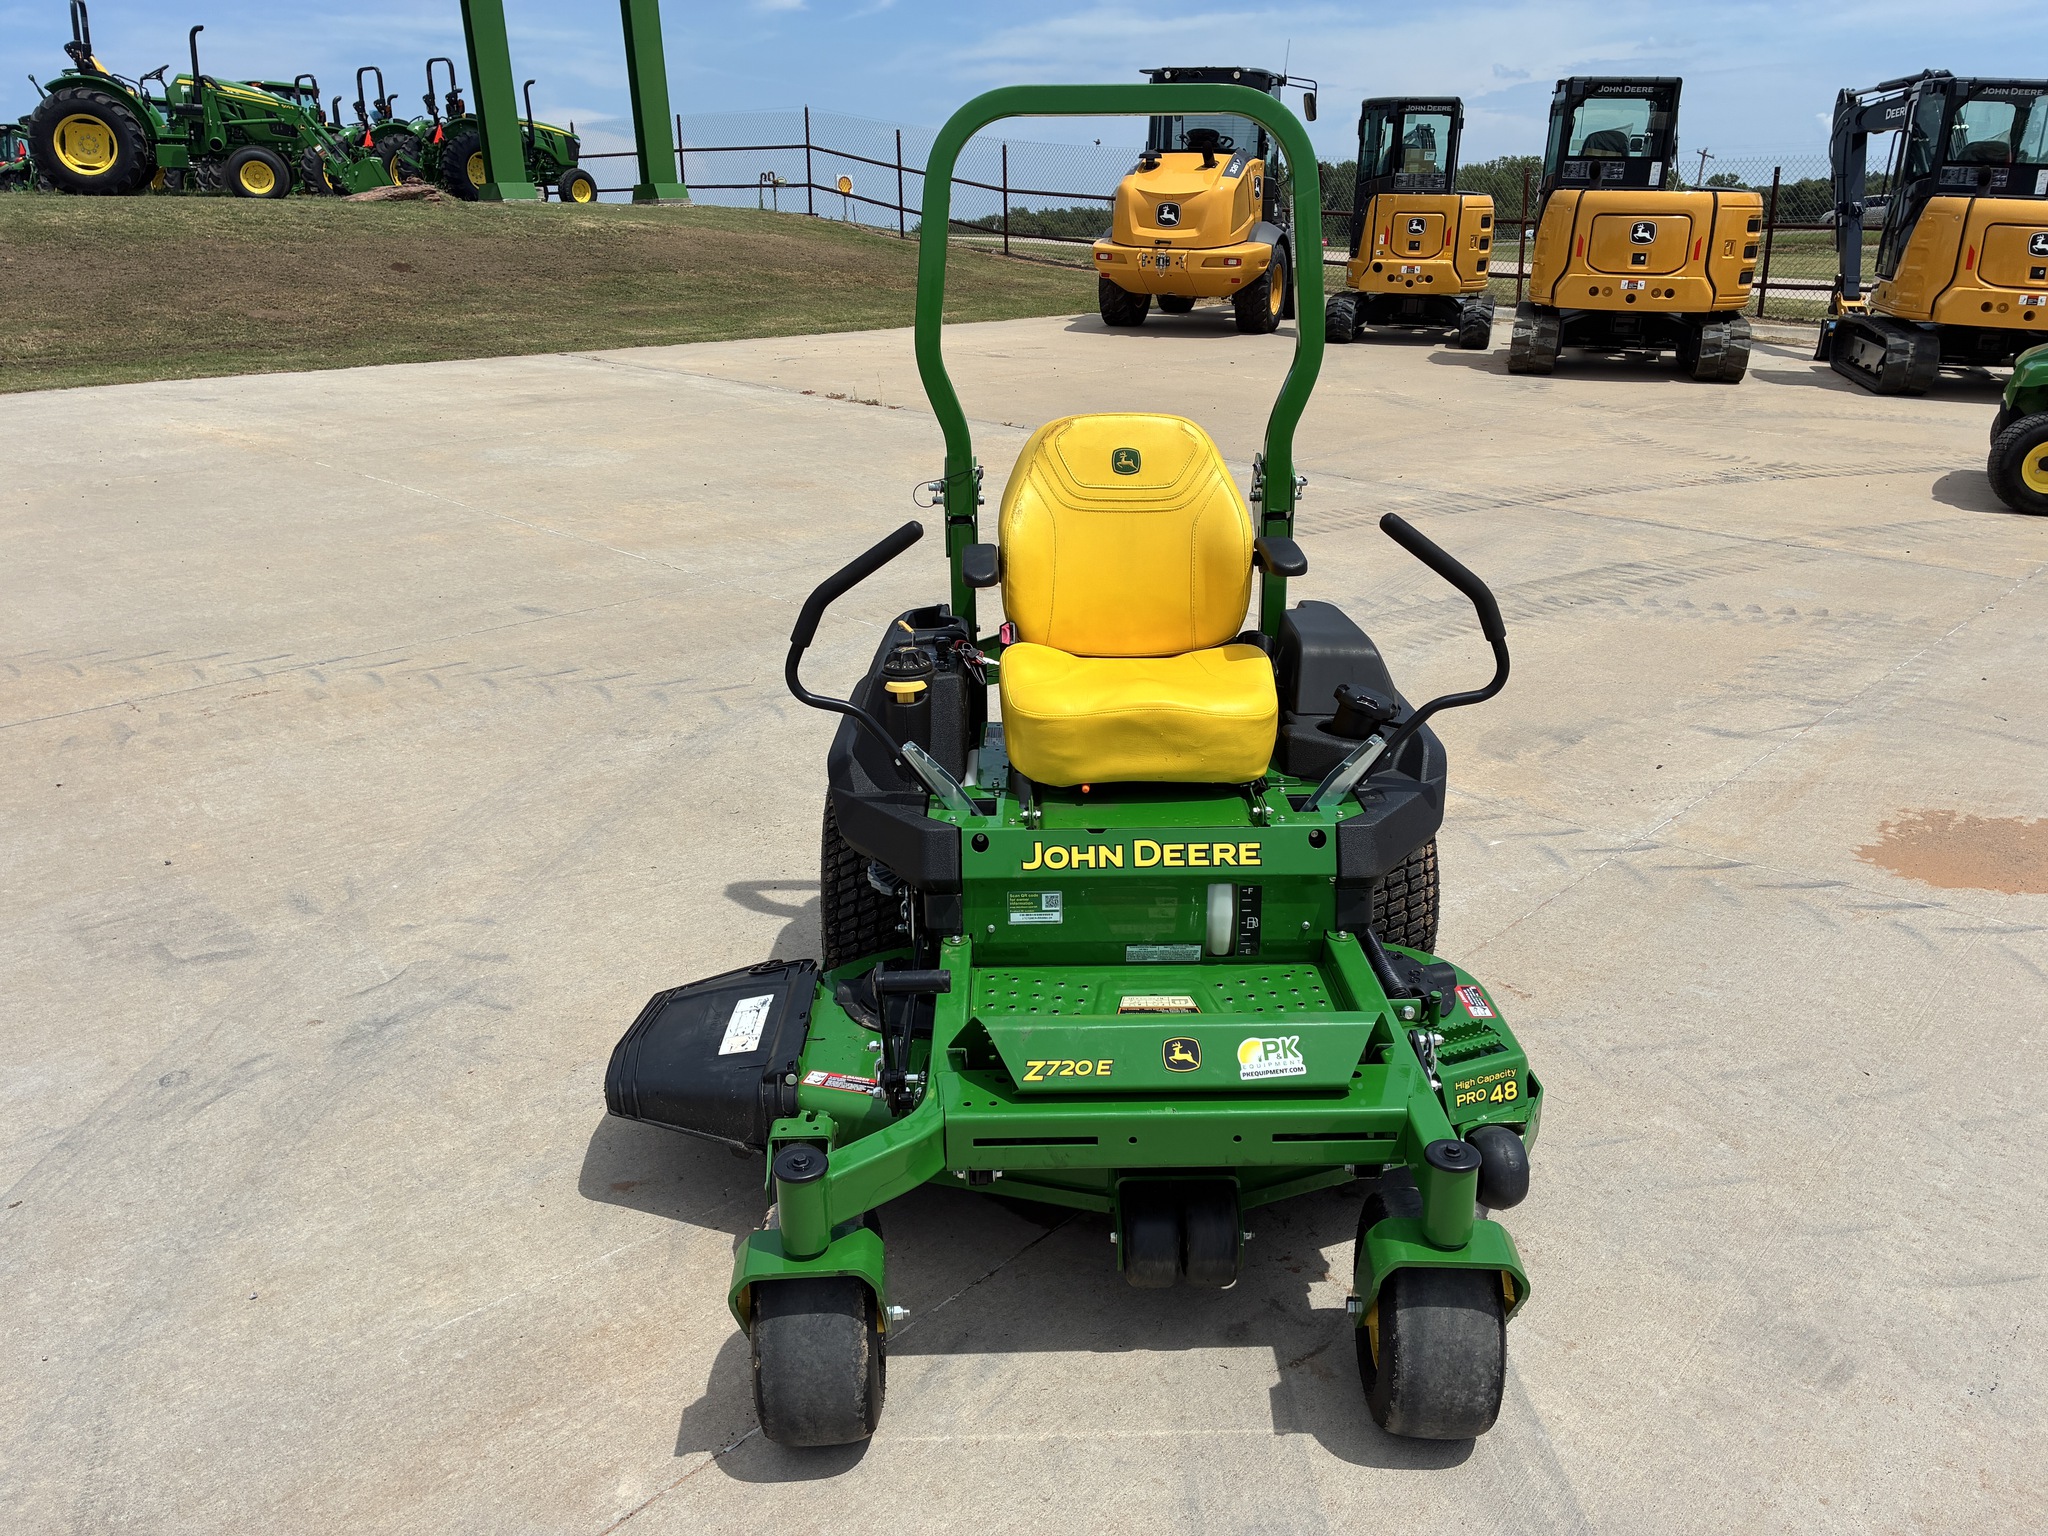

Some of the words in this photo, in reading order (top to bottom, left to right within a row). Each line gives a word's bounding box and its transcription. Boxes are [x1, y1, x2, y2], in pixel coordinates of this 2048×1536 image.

[1598, 85, 1622, 93] JOHN
[1624, 85, 1654, 93] DEERE
[1982, 87, 2009, 95] JOHN
[2010, 87, 2044, 96] DEERE
[1427, 104, 1452, 112] DEERE
[1885, 107, 1906, 120] DEER
[1021, 841, 1124, 871] JOHN
[1132, 839, 1262, 868] DEERE
[1242, 1059, 1301, 1070] EQUIPMENT
[1241, 1066, 1305, 1078] PKEQUIPMENT.COM
[1455, 1079, 1476, 1091] High
[1476, 1068, 1518, 1085] Capacity
[1456, 1088, 1488, 1108] PRO
[1489, 1080, 1519, 1104] 48
